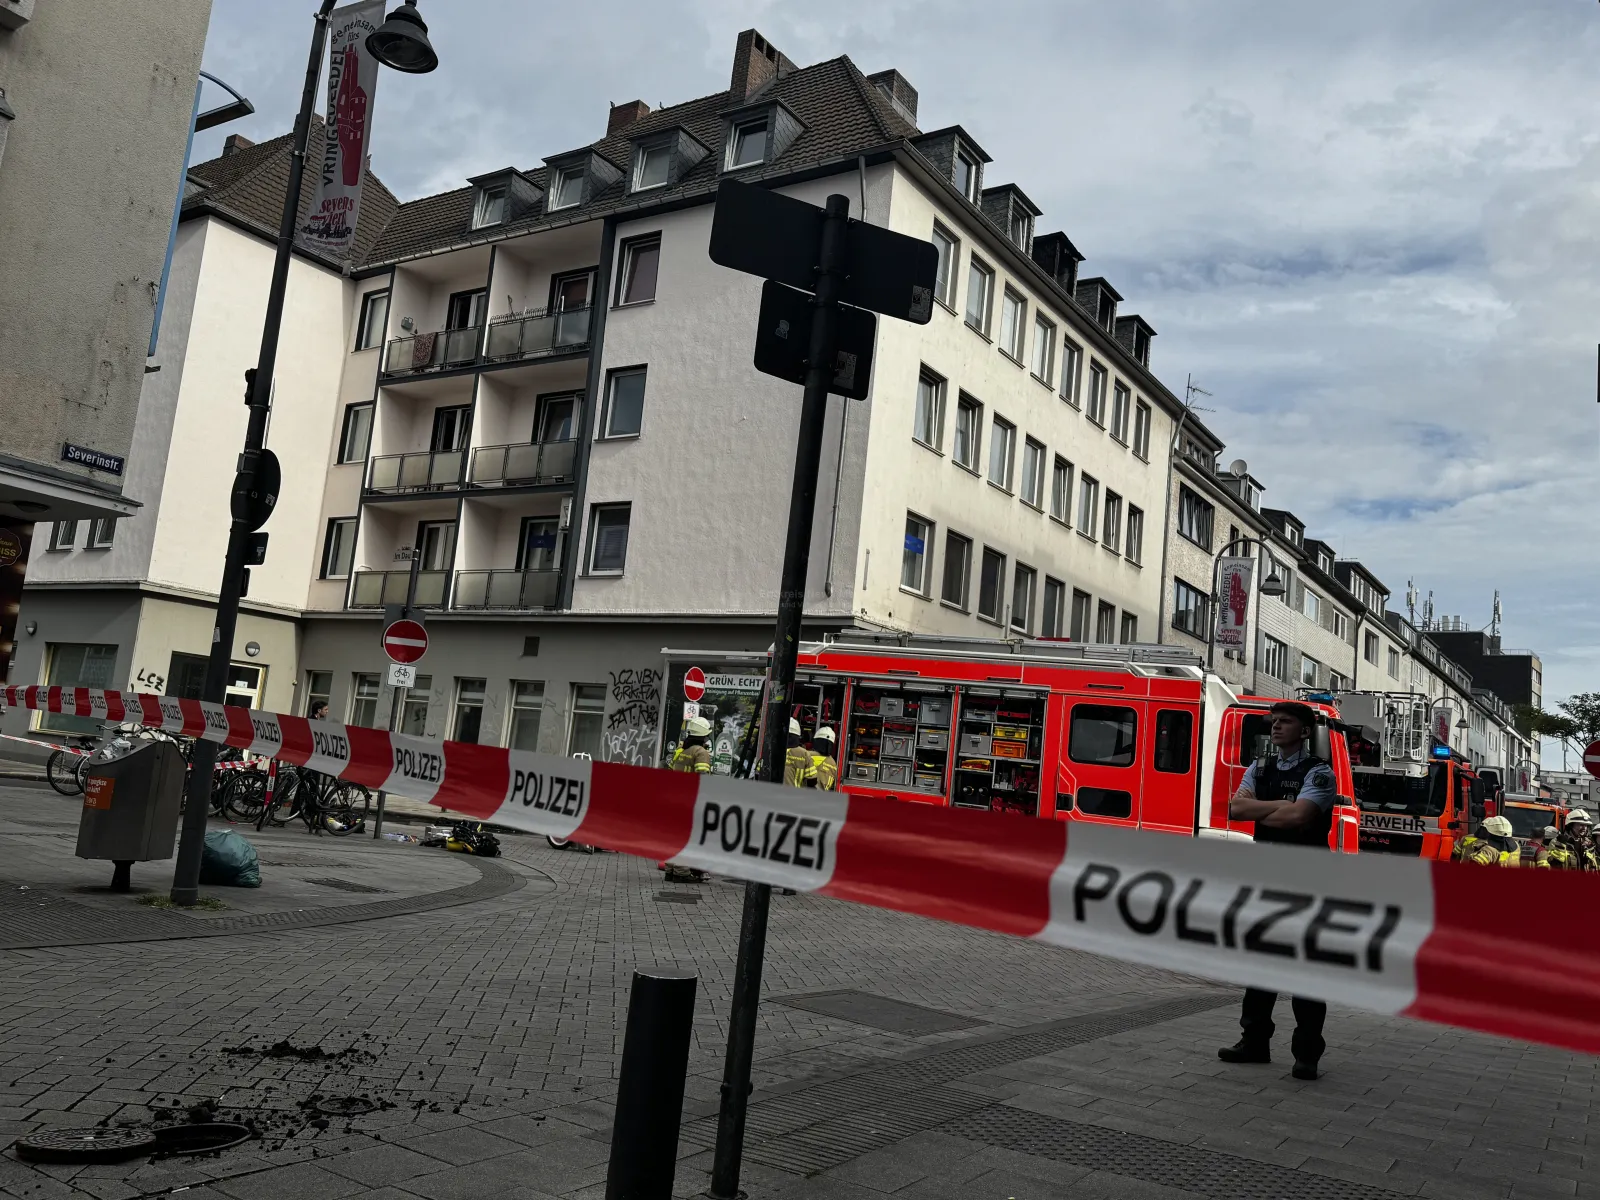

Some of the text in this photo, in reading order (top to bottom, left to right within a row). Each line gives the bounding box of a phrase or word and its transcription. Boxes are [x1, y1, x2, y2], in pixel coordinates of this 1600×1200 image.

[67, 446, 120, 472] Severinstr.
[1221, 571, 1233, 625] VRINGSVEEDEL
[137, 668, 165, 692] LCZ
[396, 678, 406, 686] frei
[709, 675, 762, 688] GRÜN. ECHT
[122, 699, 143, 714] POLIZEI
[160, 703, 183, 720] POLIZEI
[203, 710, 228, 730] POLIZEI
[253, 719, 280, 743] POLIZEI
[314, 731, 348, 760] POLIZEI
[395, 748, 442, 783] POLIZEI
[510, 769, 584, 817] POLIZEI
[699, 801, 832, 870] POLIZEI
[1073, 863, 1402, 972] POLIZEI
